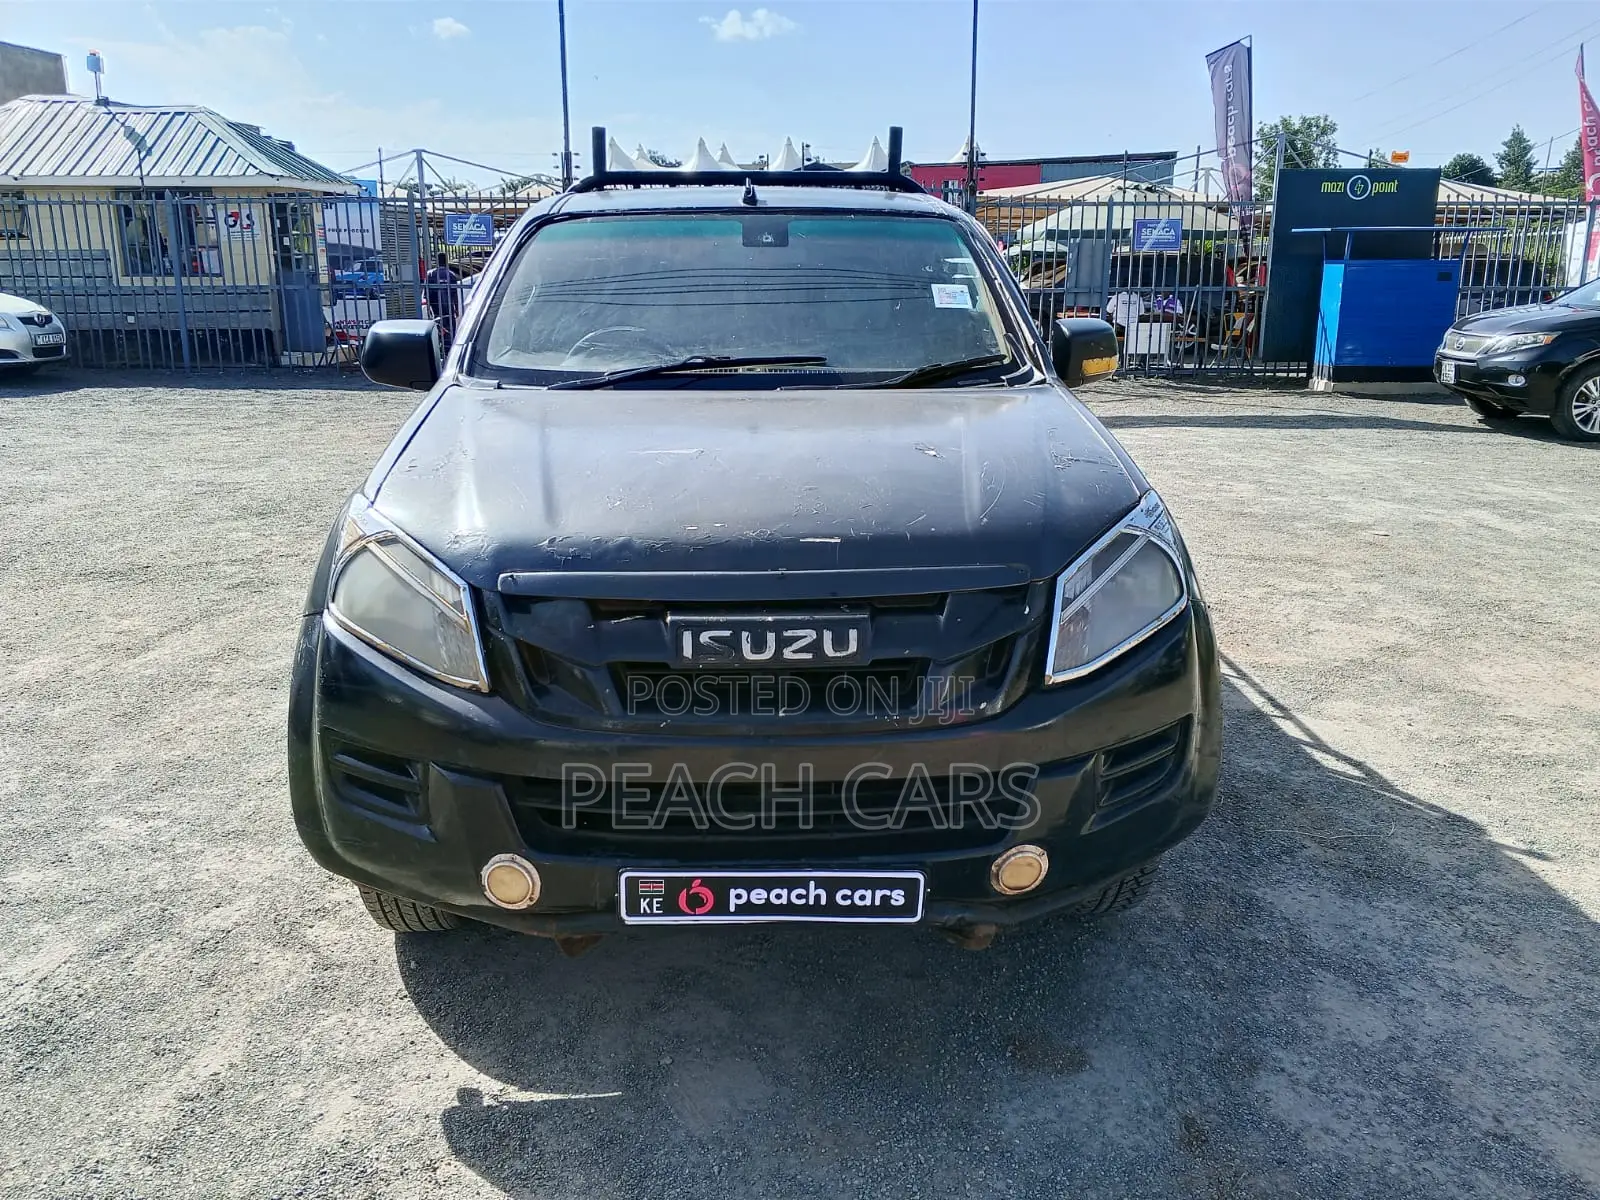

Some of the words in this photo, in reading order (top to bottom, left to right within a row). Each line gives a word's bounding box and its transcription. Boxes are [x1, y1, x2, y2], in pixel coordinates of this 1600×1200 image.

[1371, 179, 1399, 197] point
[682, 628, 858, 660] ISUZU
[640, 898, 664, 914] KE
[729, 880, 827, 913] peach
[835, 887, 905, 907] cars
